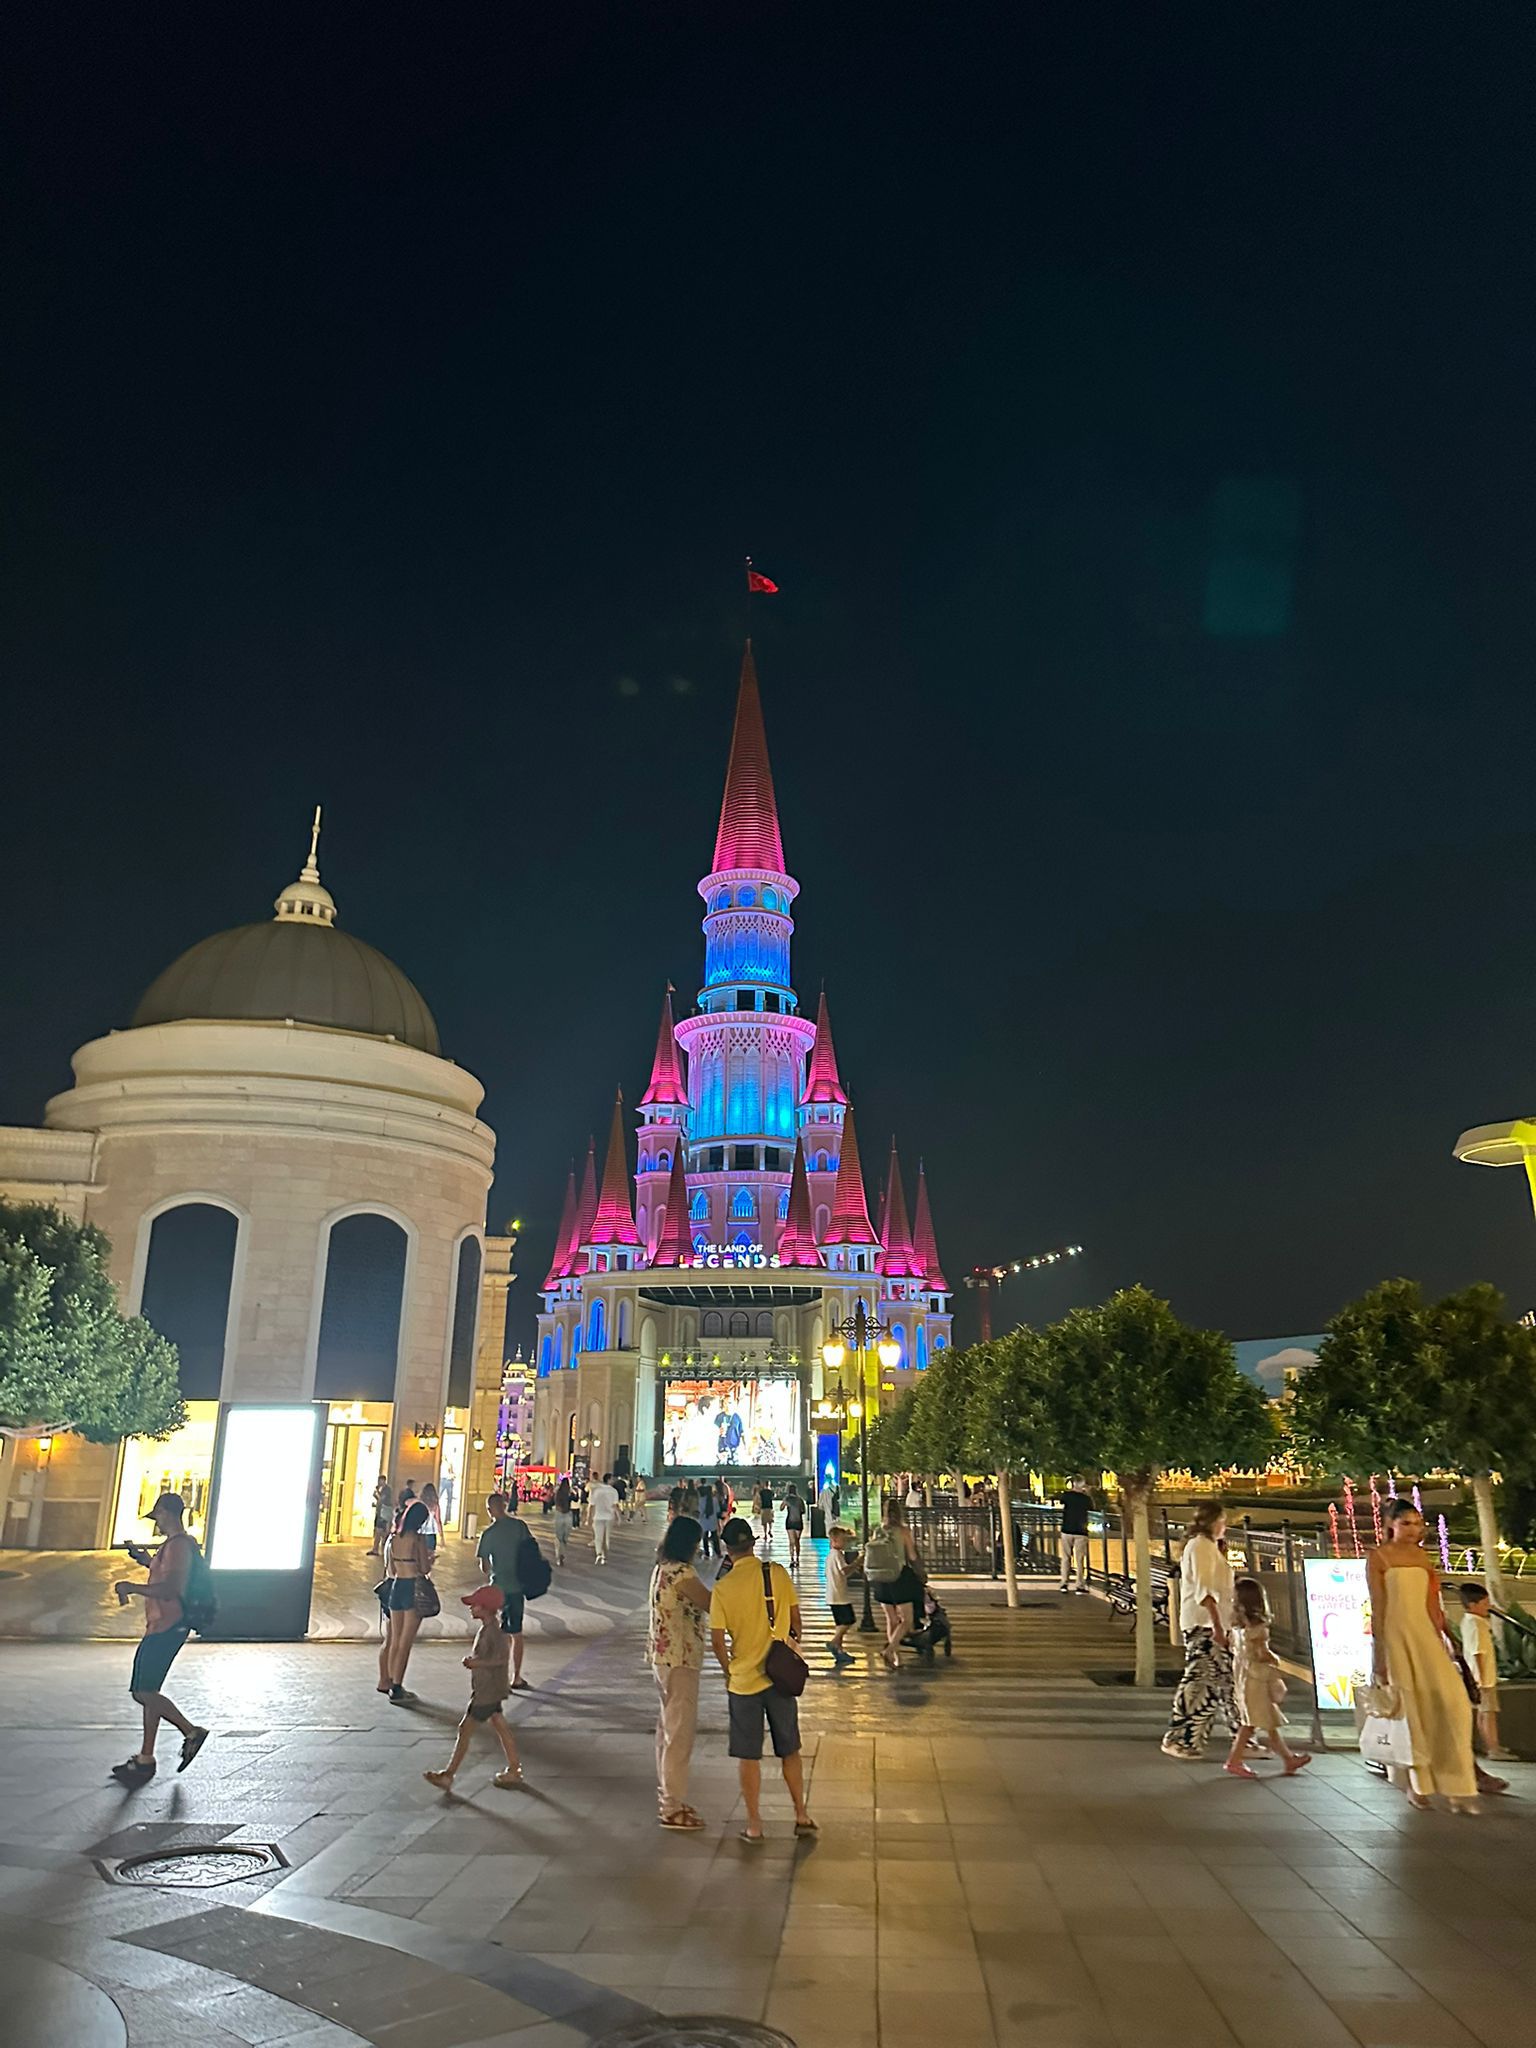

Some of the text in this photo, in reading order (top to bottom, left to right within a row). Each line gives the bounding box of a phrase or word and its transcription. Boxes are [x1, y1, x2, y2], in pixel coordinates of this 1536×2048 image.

[697, 1244, 763, 1254] THE LAND OF
[679, 1254, 781, 1269] LEGENDS
